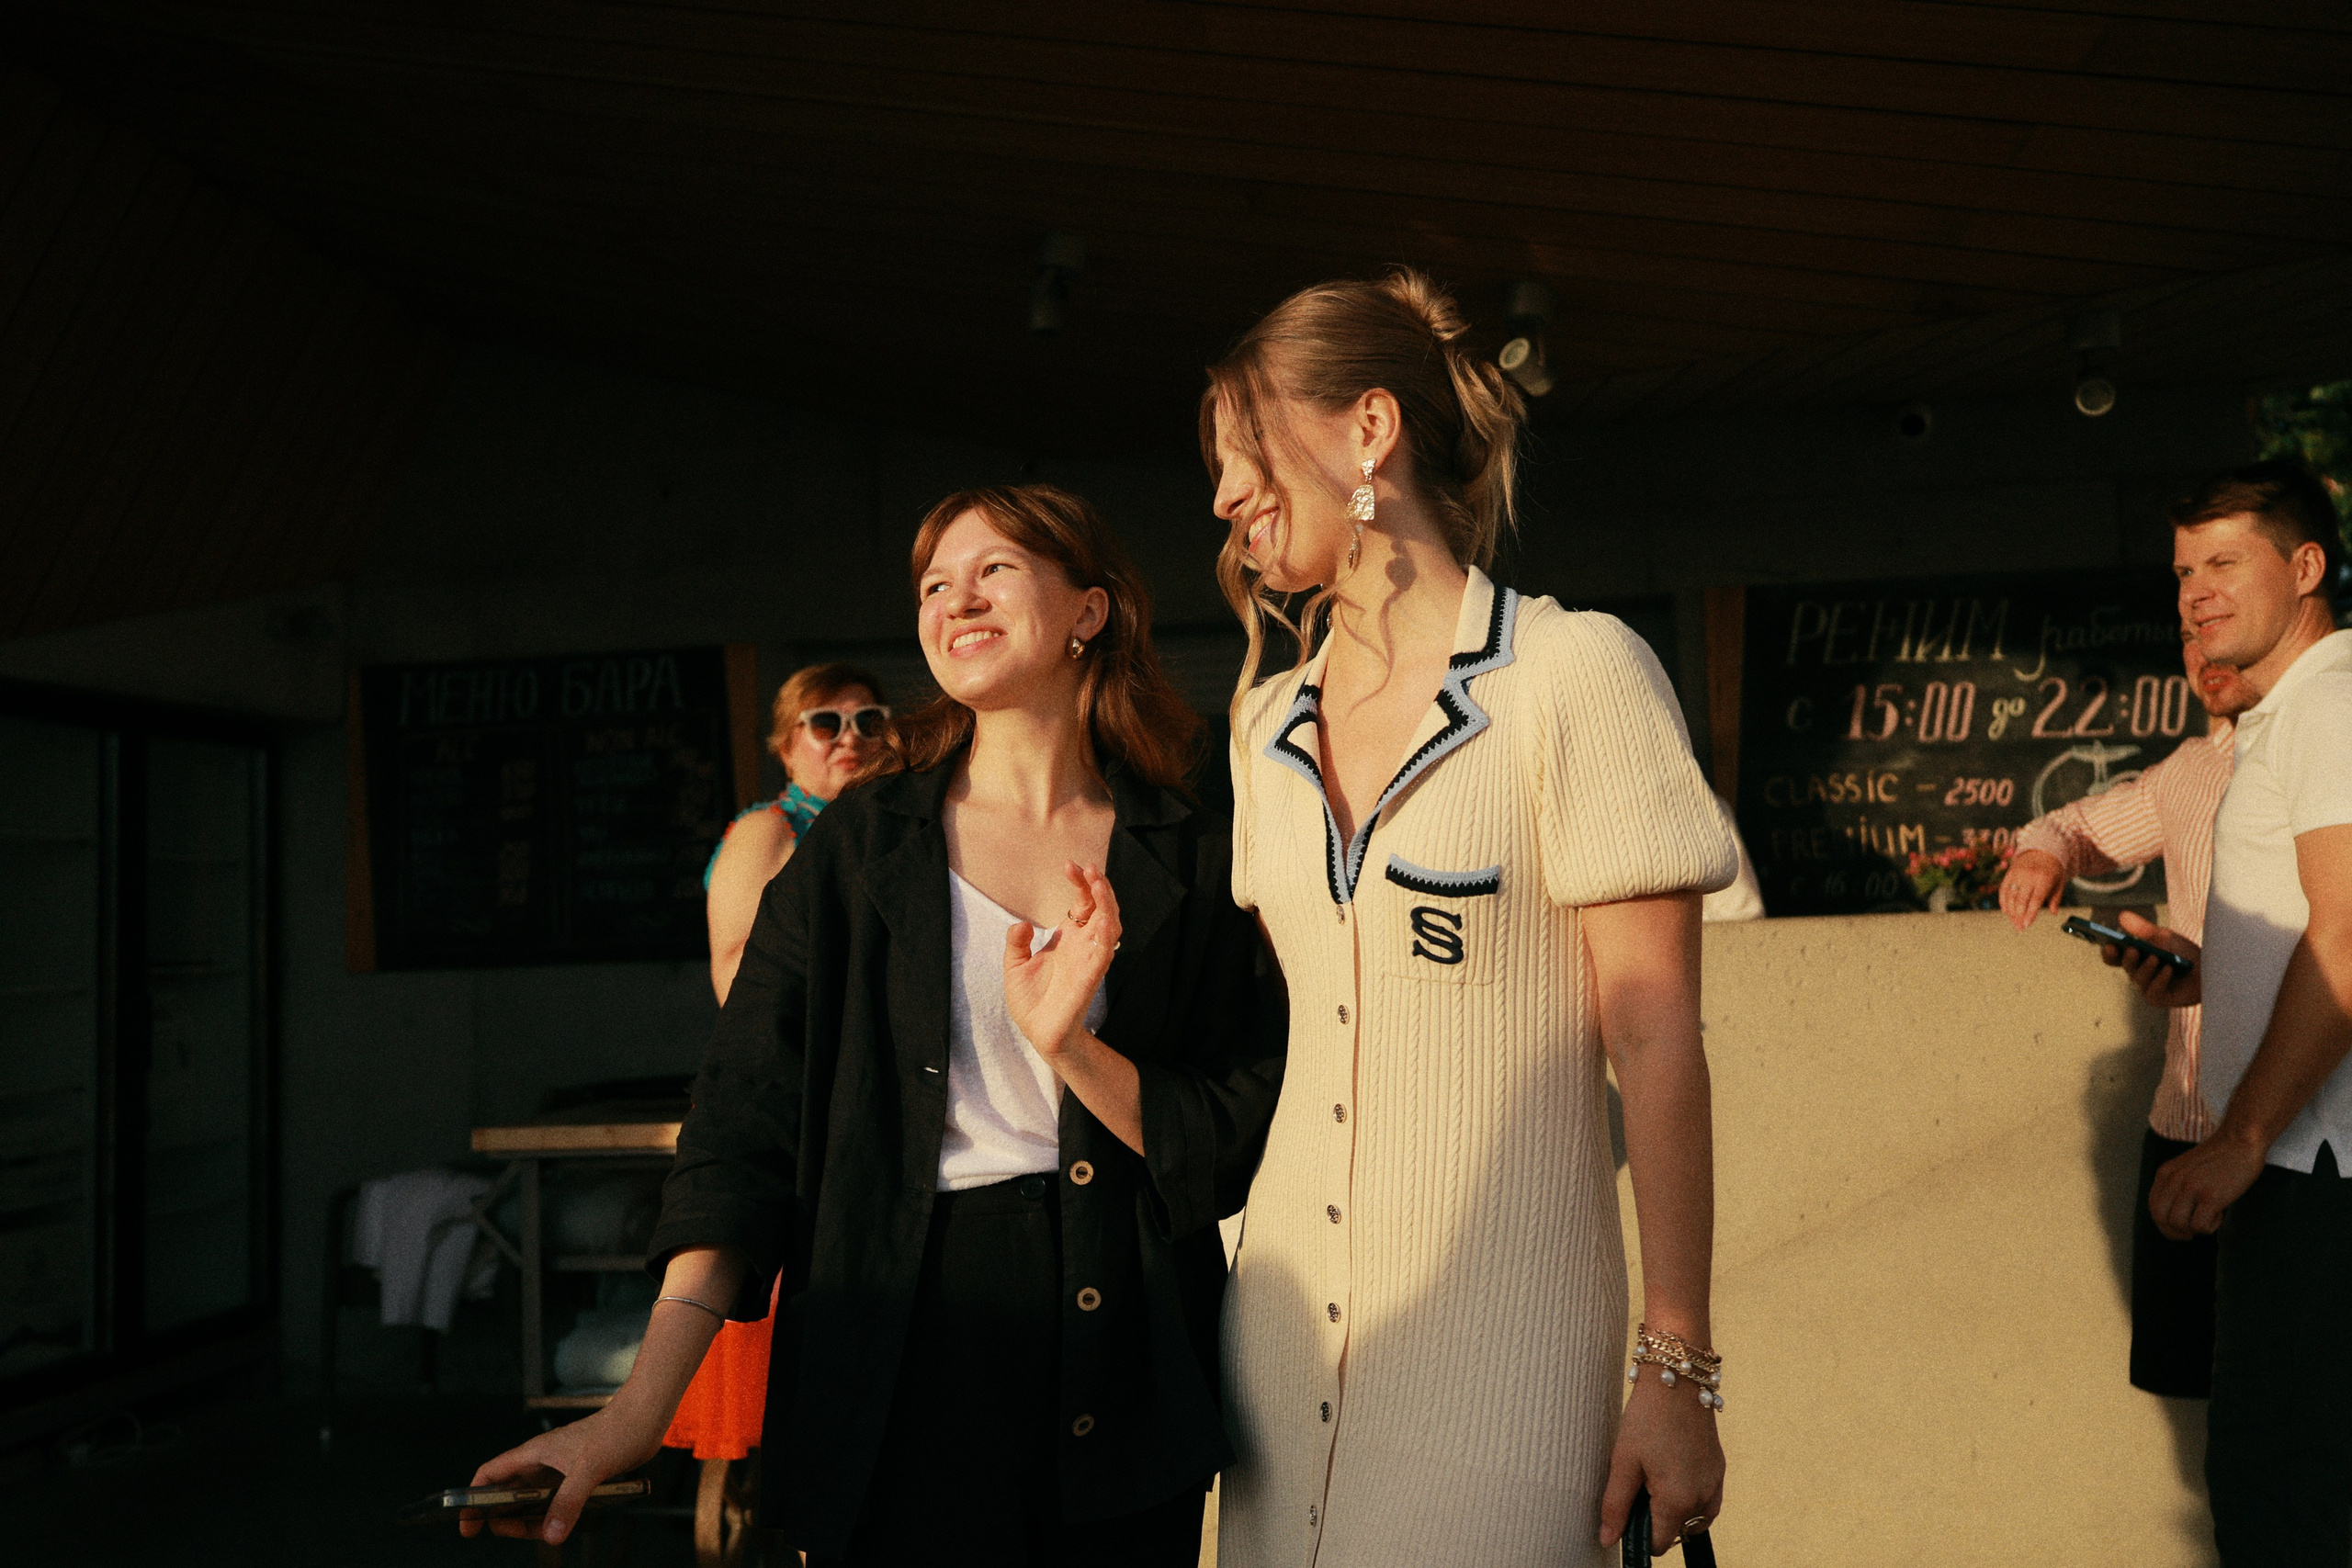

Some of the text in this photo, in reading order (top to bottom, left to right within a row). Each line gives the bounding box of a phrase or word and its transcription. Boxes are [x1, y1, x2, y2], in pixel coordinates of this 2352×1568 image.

[398, 653, 684, 727] МЕНЮ БАРА
[1841, 681, 1976, 742] 15:00
[2030, 674, 2190, 739] 22:00
[1943, 776, 2015, 807] 2500
